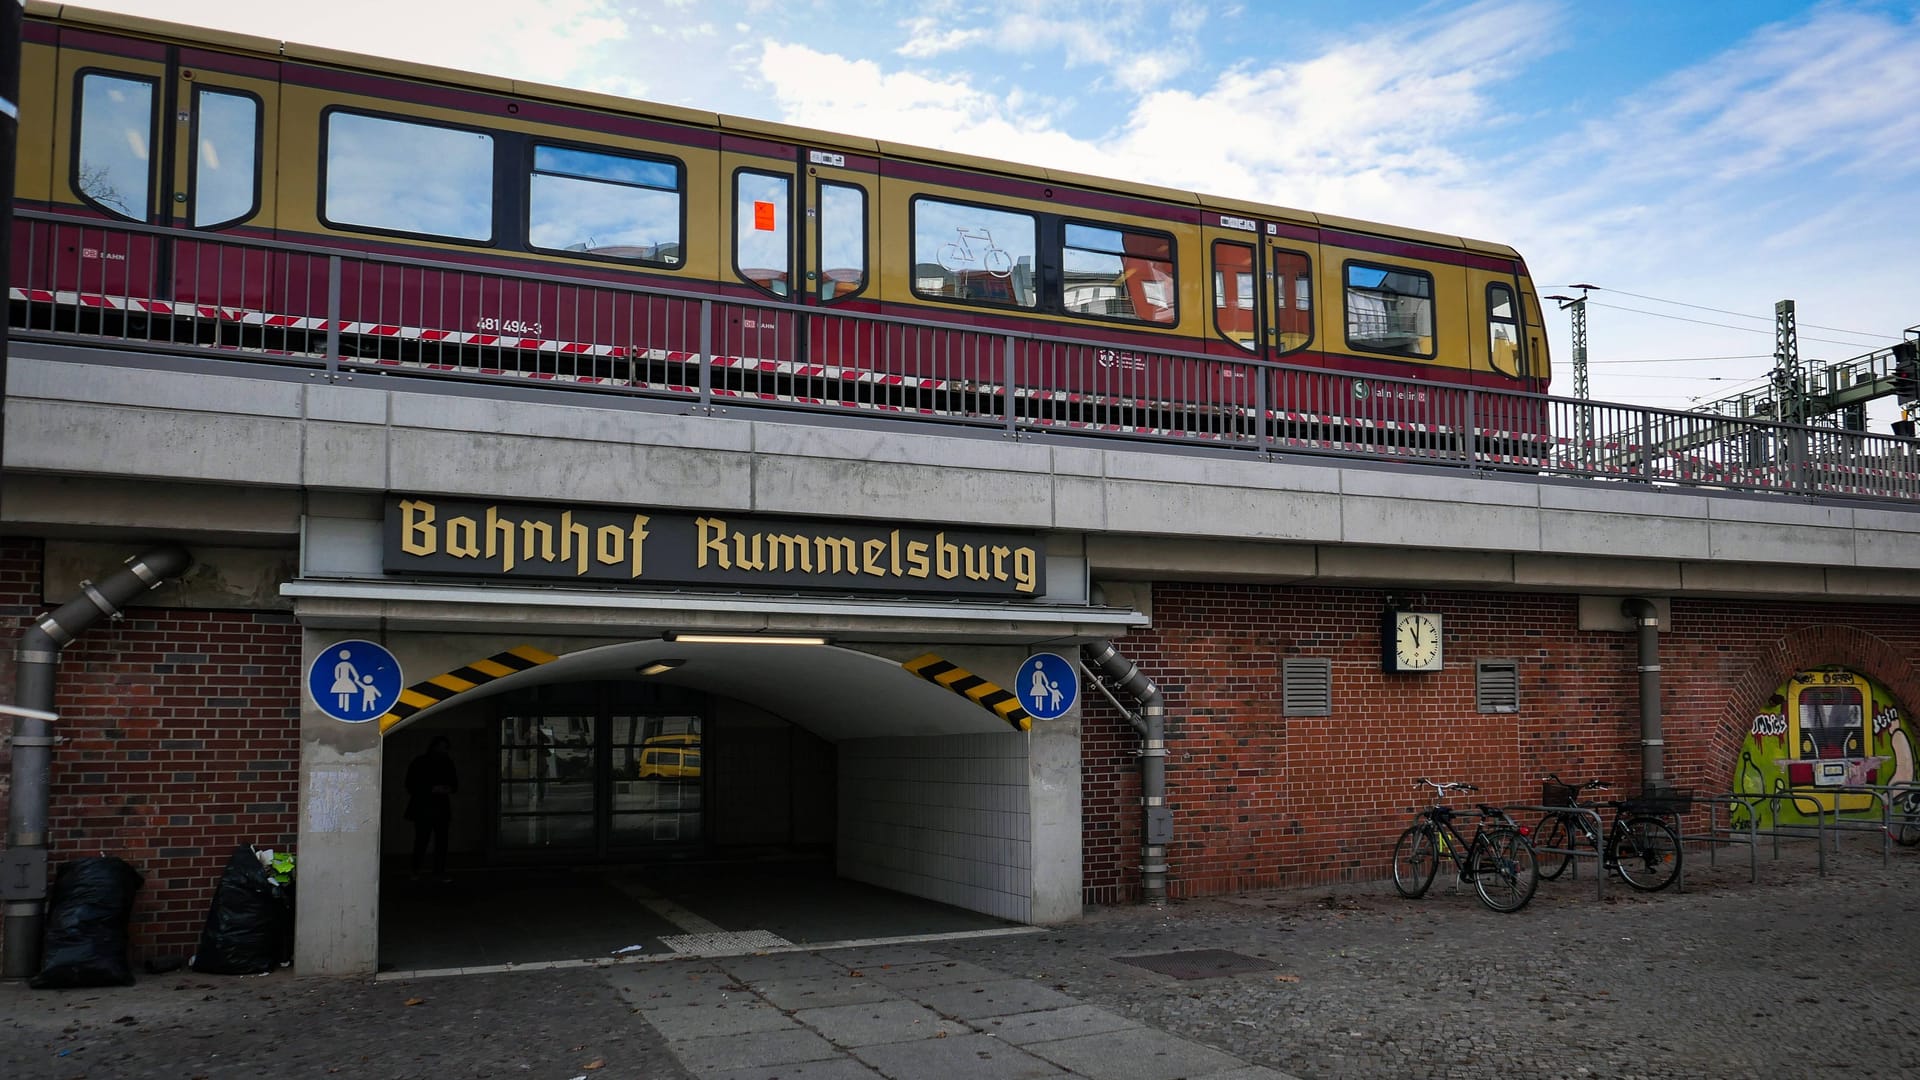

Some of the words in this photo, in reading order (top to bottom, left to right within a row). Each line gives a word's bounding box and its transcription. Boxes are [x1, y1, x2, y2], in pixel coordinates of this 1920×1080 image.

[476, 317, 499, 331] 481
[502, 320, 542, 335] 494-3
[399, 499, 650, 578] Bahnhof
[695, 517, 1036, 593] Rummelsburg
